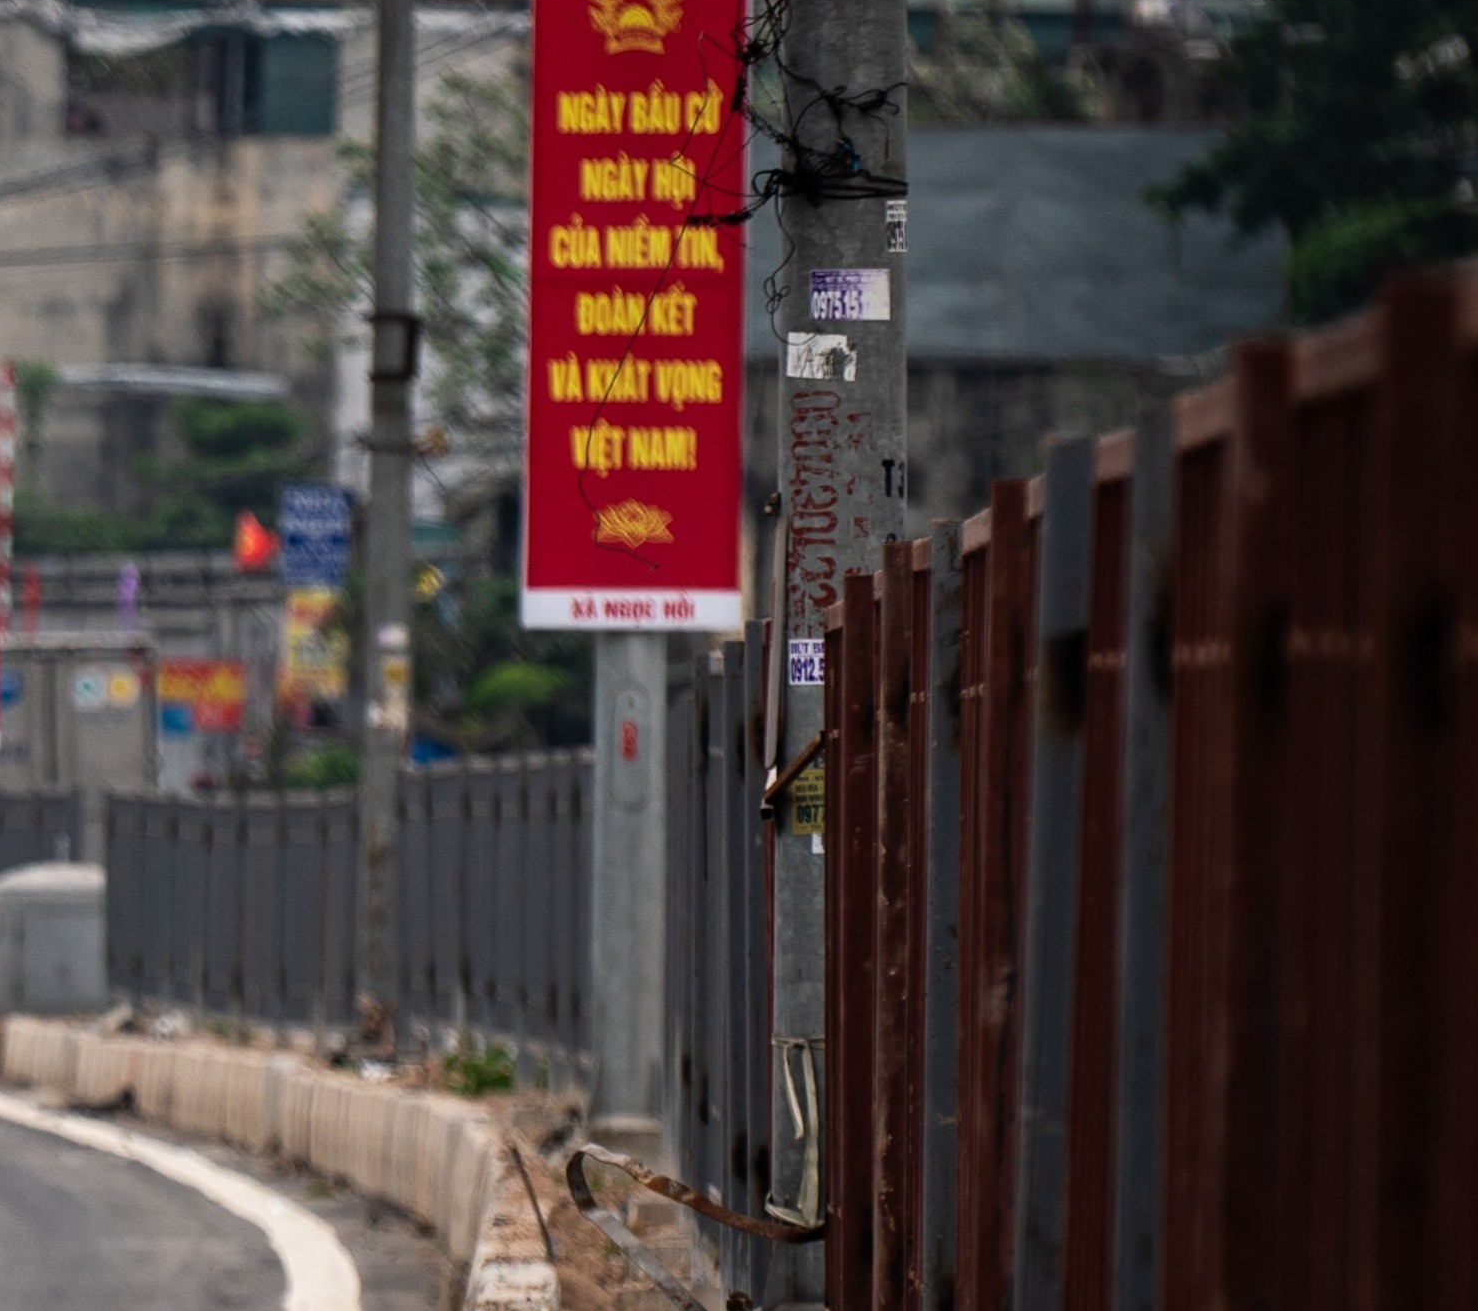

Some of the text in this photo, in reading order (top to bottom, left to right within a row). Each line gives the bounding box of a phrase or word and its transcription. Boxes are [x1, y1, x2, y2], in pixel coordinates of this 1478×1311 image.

[557, 77, 724, 135] NGÀY BẦU CỬ
[579, 150, 697, 210] NGÀY HỘI
[549, 212, 602, 269] CỦA
[604, 213, 671, 269] NIỀM
[575, 280, 697, 336] ĐOÀN KẾT
[547, 350, 723, 412] VÀ KHÁT VỌNG
[570, 417, 697, 478] VIỆT NAM!
